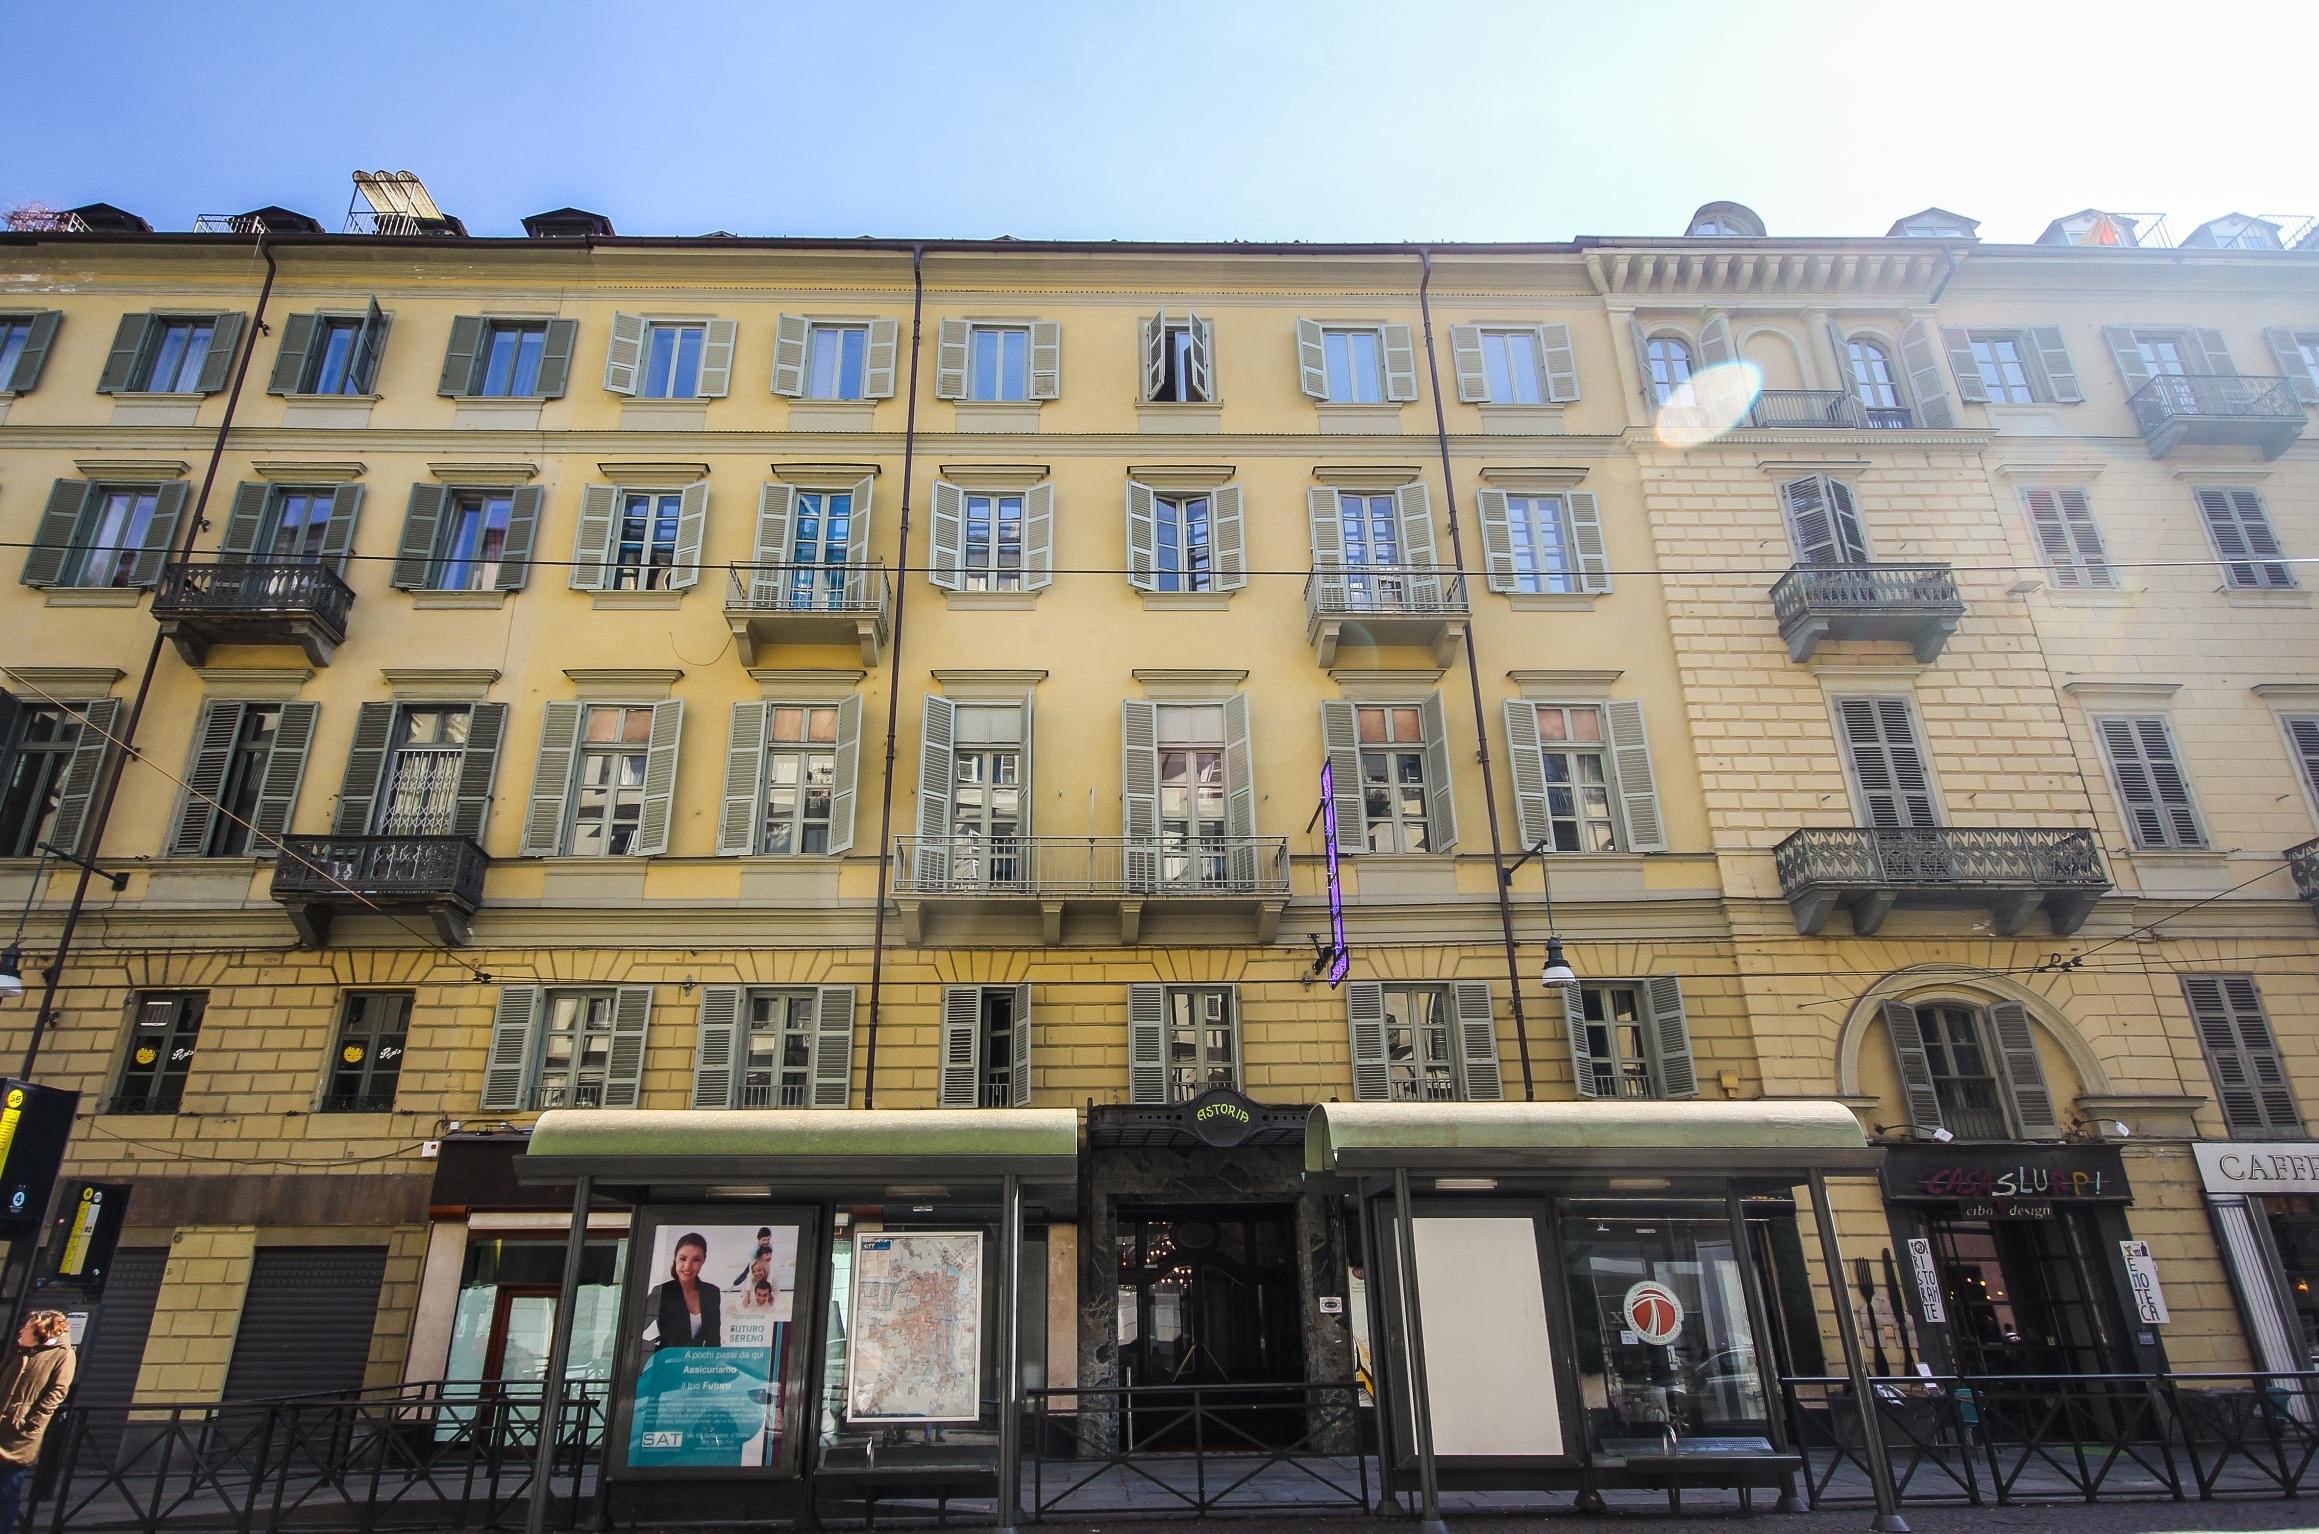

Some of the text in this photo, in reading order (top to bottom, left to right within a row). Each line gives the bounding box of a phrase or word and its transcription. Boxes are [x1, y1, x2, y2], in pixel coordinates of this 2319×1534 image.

[1196, 1103, 1249, 1123] ASTORIA
[2008, 1204, 2051, 1219] design
[730, 1325, 764, 1333] FUTURO
[729, 1334, 764, 1343] SERENO
[684, 1351, 764, 1360] A pochi passi da qui
[683, 1365, 738, 1374] Assicuriamo
[687, 1382, 701, 1390] tuo
[702, 1381, 732, 1390] Futuro
[642, 1433, 682, 1446] SAT
